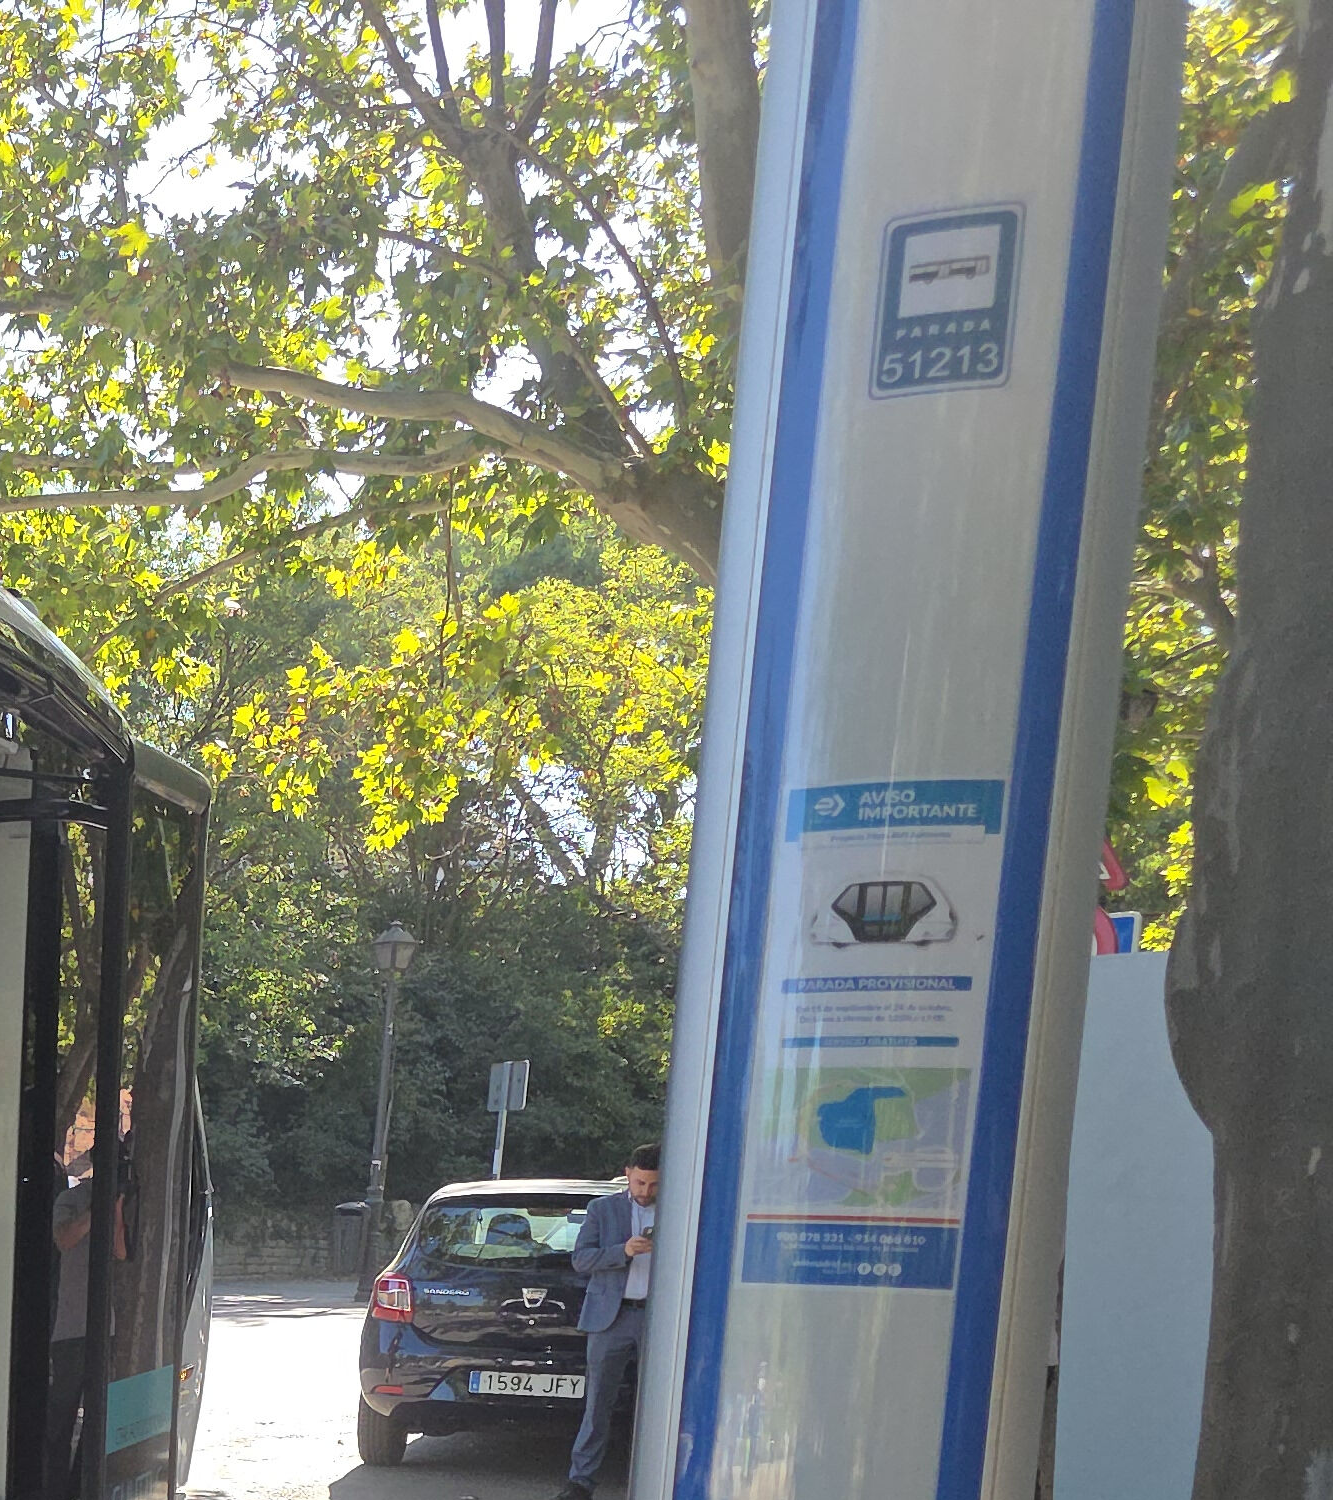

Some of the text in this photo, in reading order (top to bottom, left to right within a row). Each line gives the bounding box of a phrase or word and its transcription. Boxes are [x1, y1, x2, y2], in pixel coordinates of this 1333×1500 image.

[895, 319, 991, 341] PARADA
[880, 343, 1000, 384] 51213
[859, 789, 916, 805] AVISO
[858, 803, 977, 821] IMPORTANTE
[797, 977, 956, 992] PARADA PROVISIONAL
[486, 1373, 534, 1393] 1594
[542, 1376, 581, 1395] JFY
